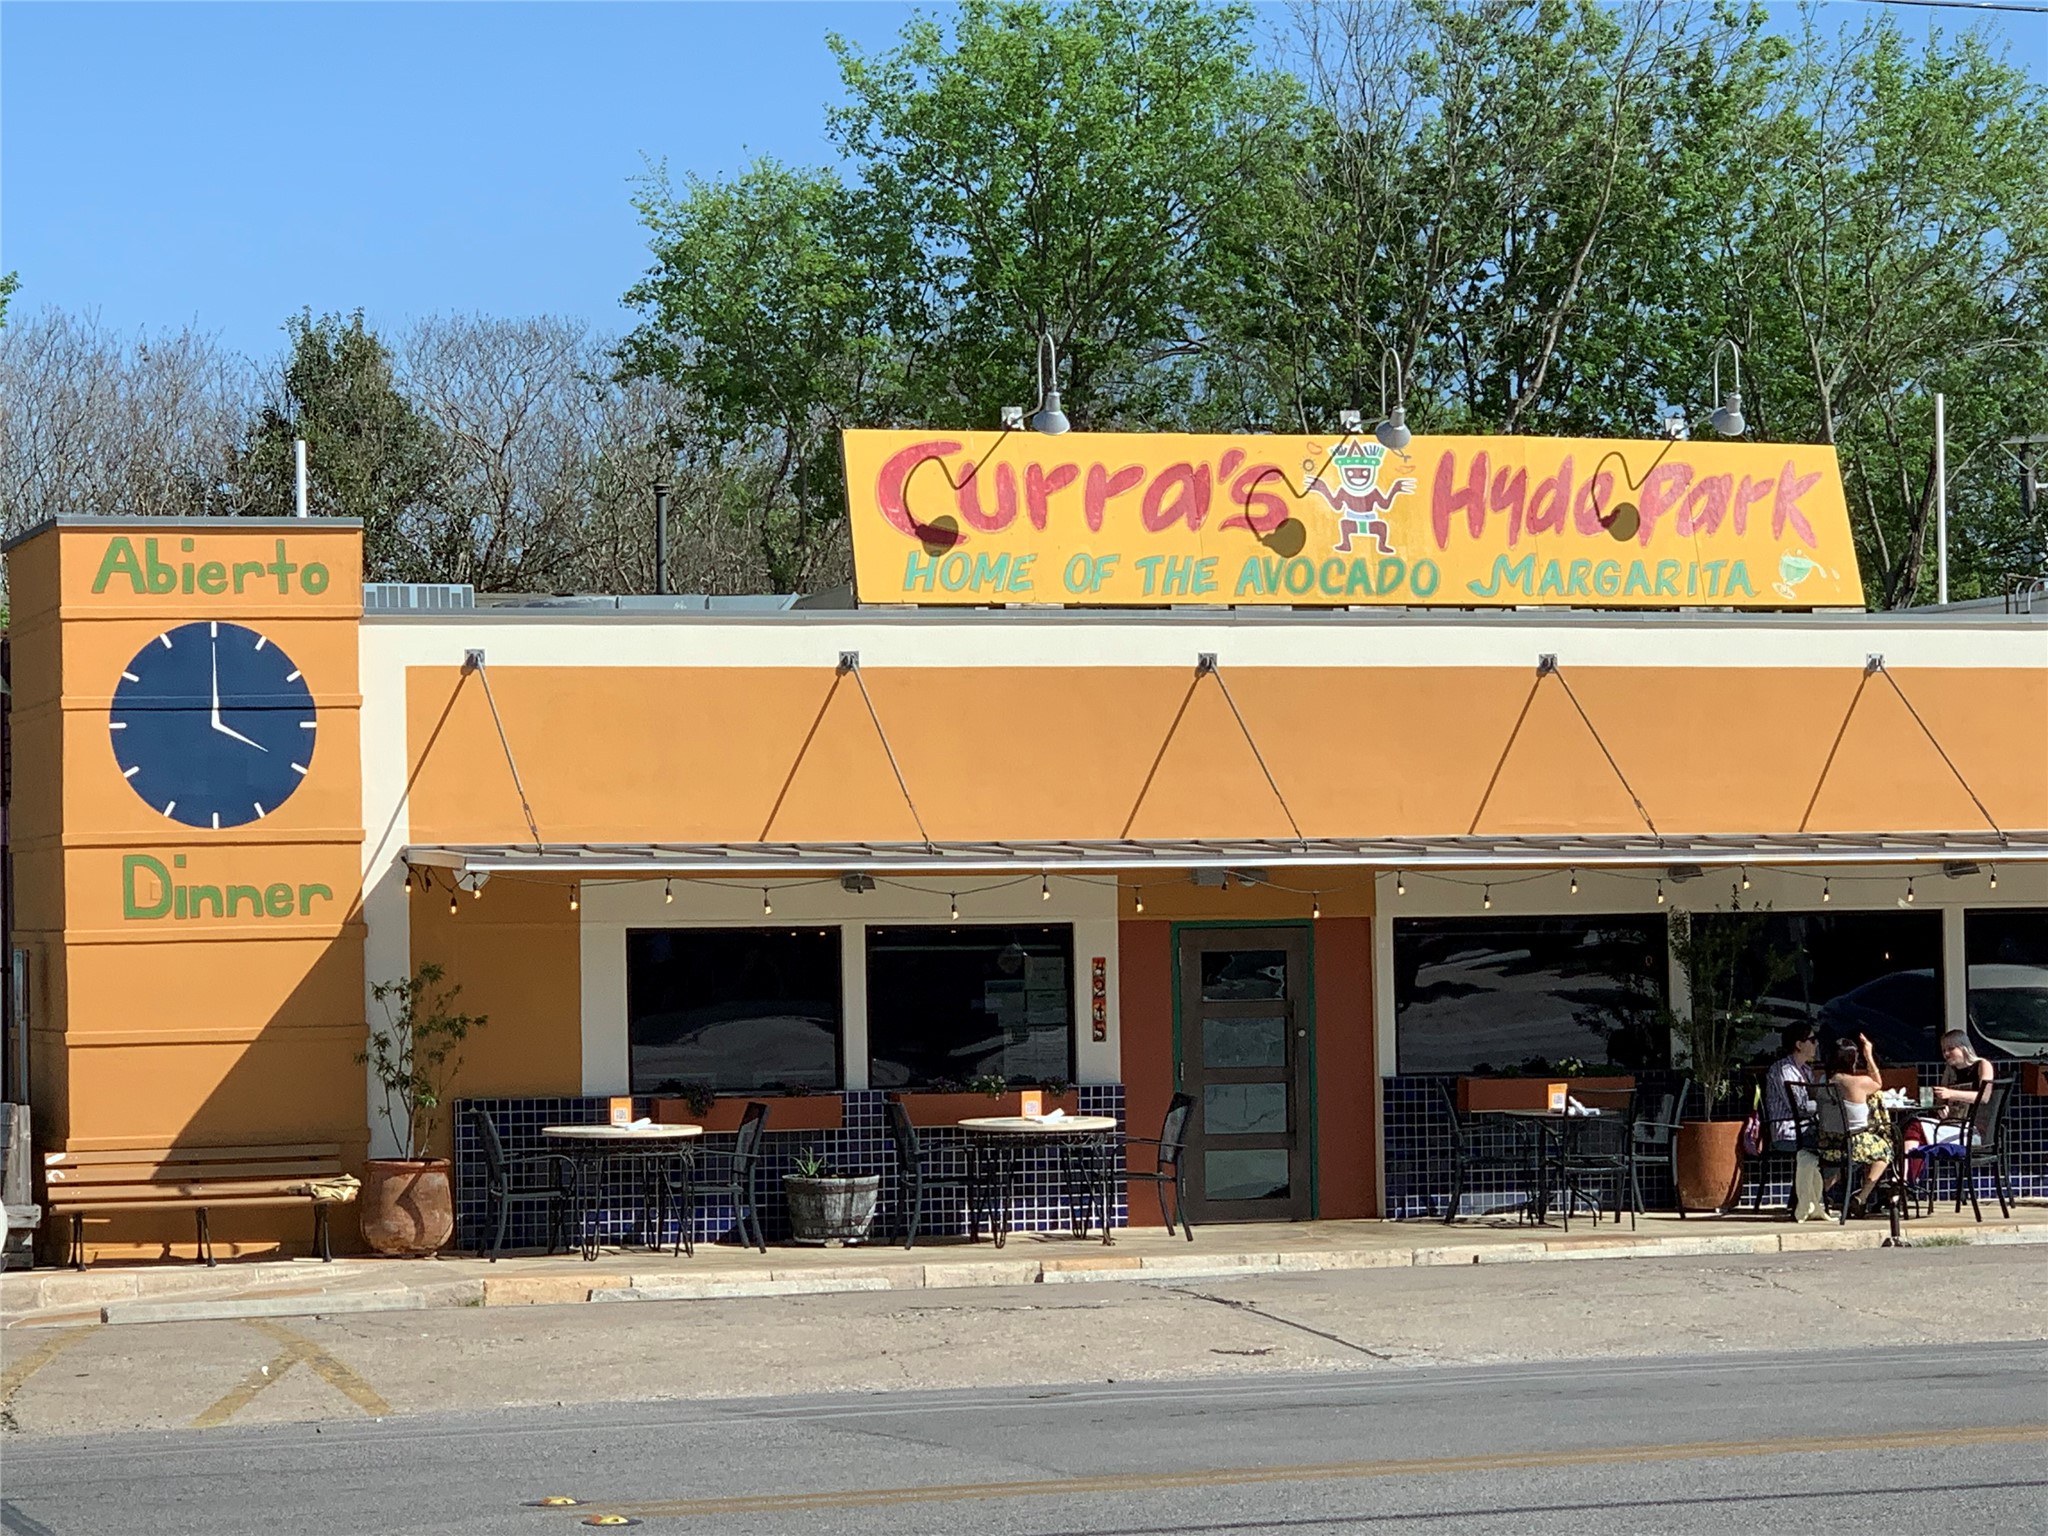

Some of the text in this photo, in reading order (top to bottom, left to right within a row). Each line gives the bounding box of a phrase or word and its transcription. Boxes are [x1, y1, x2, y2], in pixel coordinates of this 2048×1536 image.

[875, 439, 1823, 552] Curra's Hyde Park
[91, 537, 330, 595] Abierto
[904, 550, 1761, 597] HOME OF THE AVOCADO MARGARITA
[122, 854, 333, 920] Dinner
